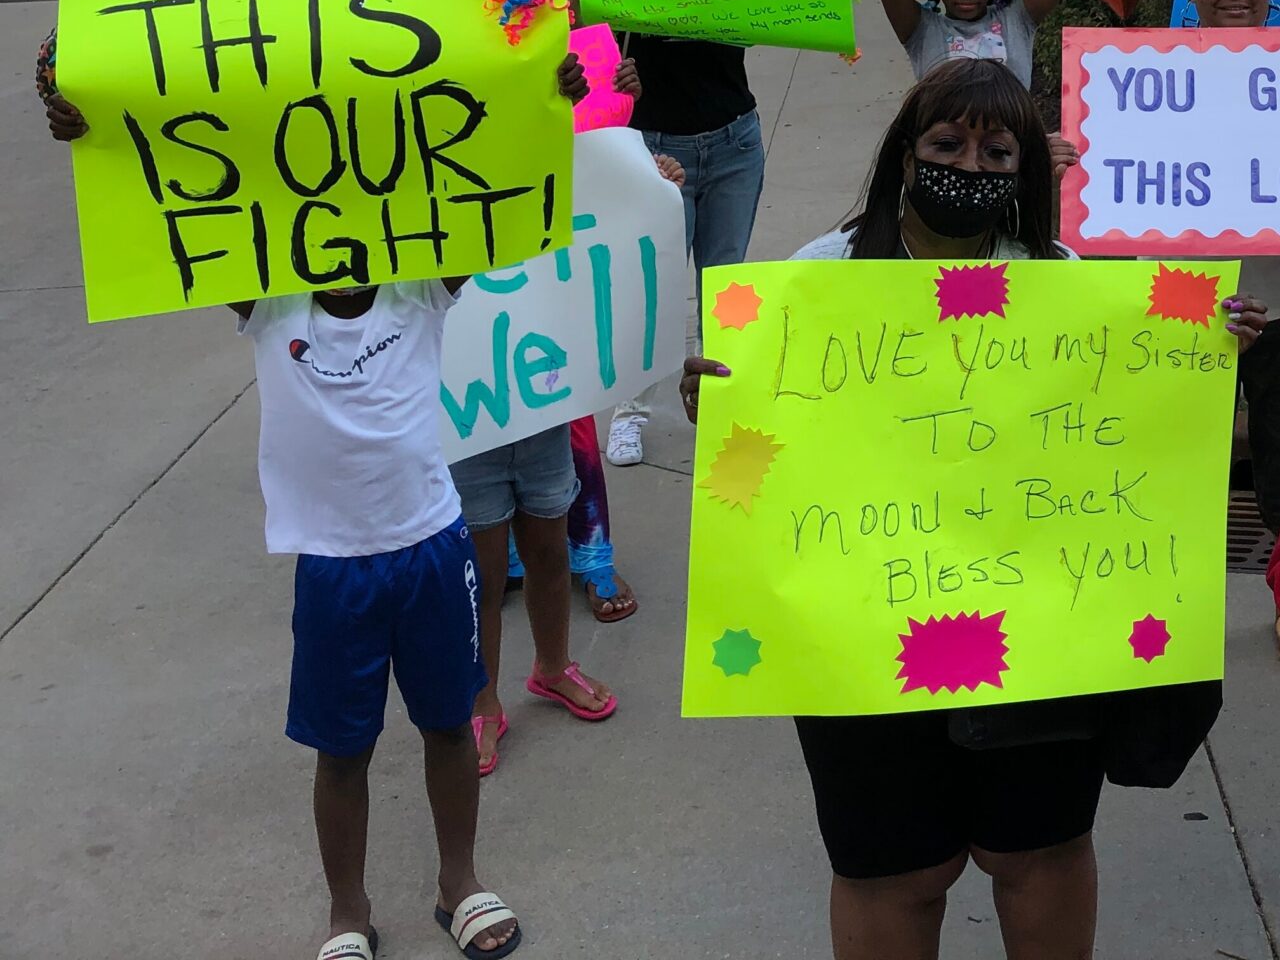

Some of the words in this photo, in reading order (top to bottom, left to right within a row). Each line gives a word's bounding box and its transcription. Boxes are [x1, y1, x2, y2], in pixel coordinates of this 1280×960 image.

[805, 10, 842, 22] sends
[1106, 67, 1196, 113] YOU
[123, 108, 242, 205] IS
[274, 79, 491, 198] OUR
[1102, 158, 1211, 207] THIS
[162, 173, 557, 304] FIGHT!
[289, 332, 402, 378] Champion
[773, 304, 928, 401] LOVE
[894, 407, 996, 454] TO
[1030, 402, 1125, 449] THE
[1016, 469, 1153, 522] BACK
[465, 900, 500, 916] NAUTICA
[322, 943, 361, 958] NAUTICA
